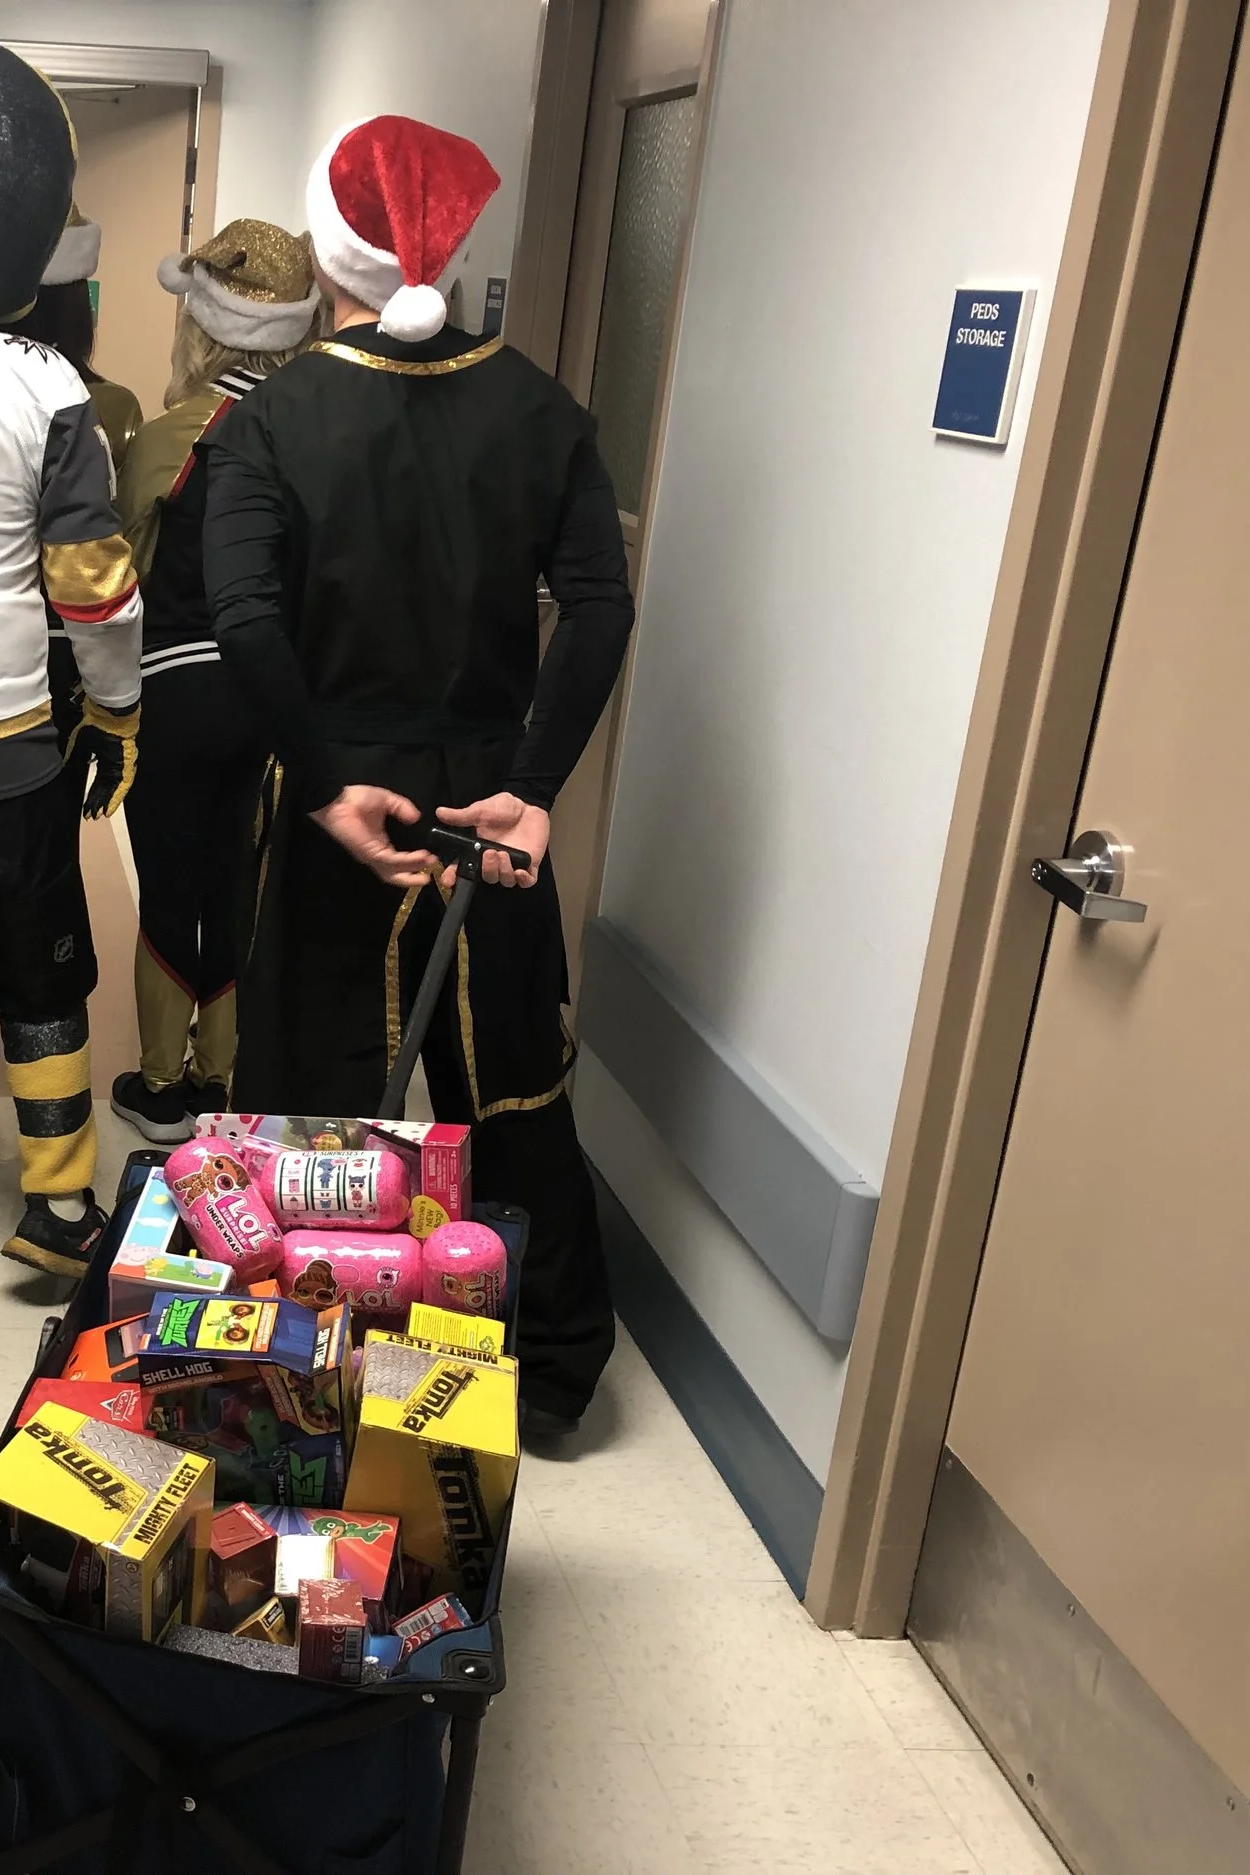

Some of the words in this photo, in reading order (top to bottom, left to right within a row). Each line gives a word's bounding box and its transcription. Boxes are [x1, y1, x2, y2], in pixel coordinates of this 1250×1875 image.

[970, 303, 1000, 321] PEDS
[955, 328, 1007, 347] STORAGE
[220, 1206, 249, 1247] SURPRISE!
[425, 1209, 435, 1228] NEW
[206, 1204, 225, 1231] UNDER
[222, 1229, 244, 1259] WRAPS
[161, 1297, 201, 1348] TURTLES
[385, 1334, 432, 1351] FLEET
[437, 1346, 498, 1365] MIGHTY
[142, 1366, 185, 1386] SHELL
[184, 1361, 214, 1377] HOG
[133, 1495, 177, 1546] MIGHTY
[165, 1461, 201, 1499] FLEET
